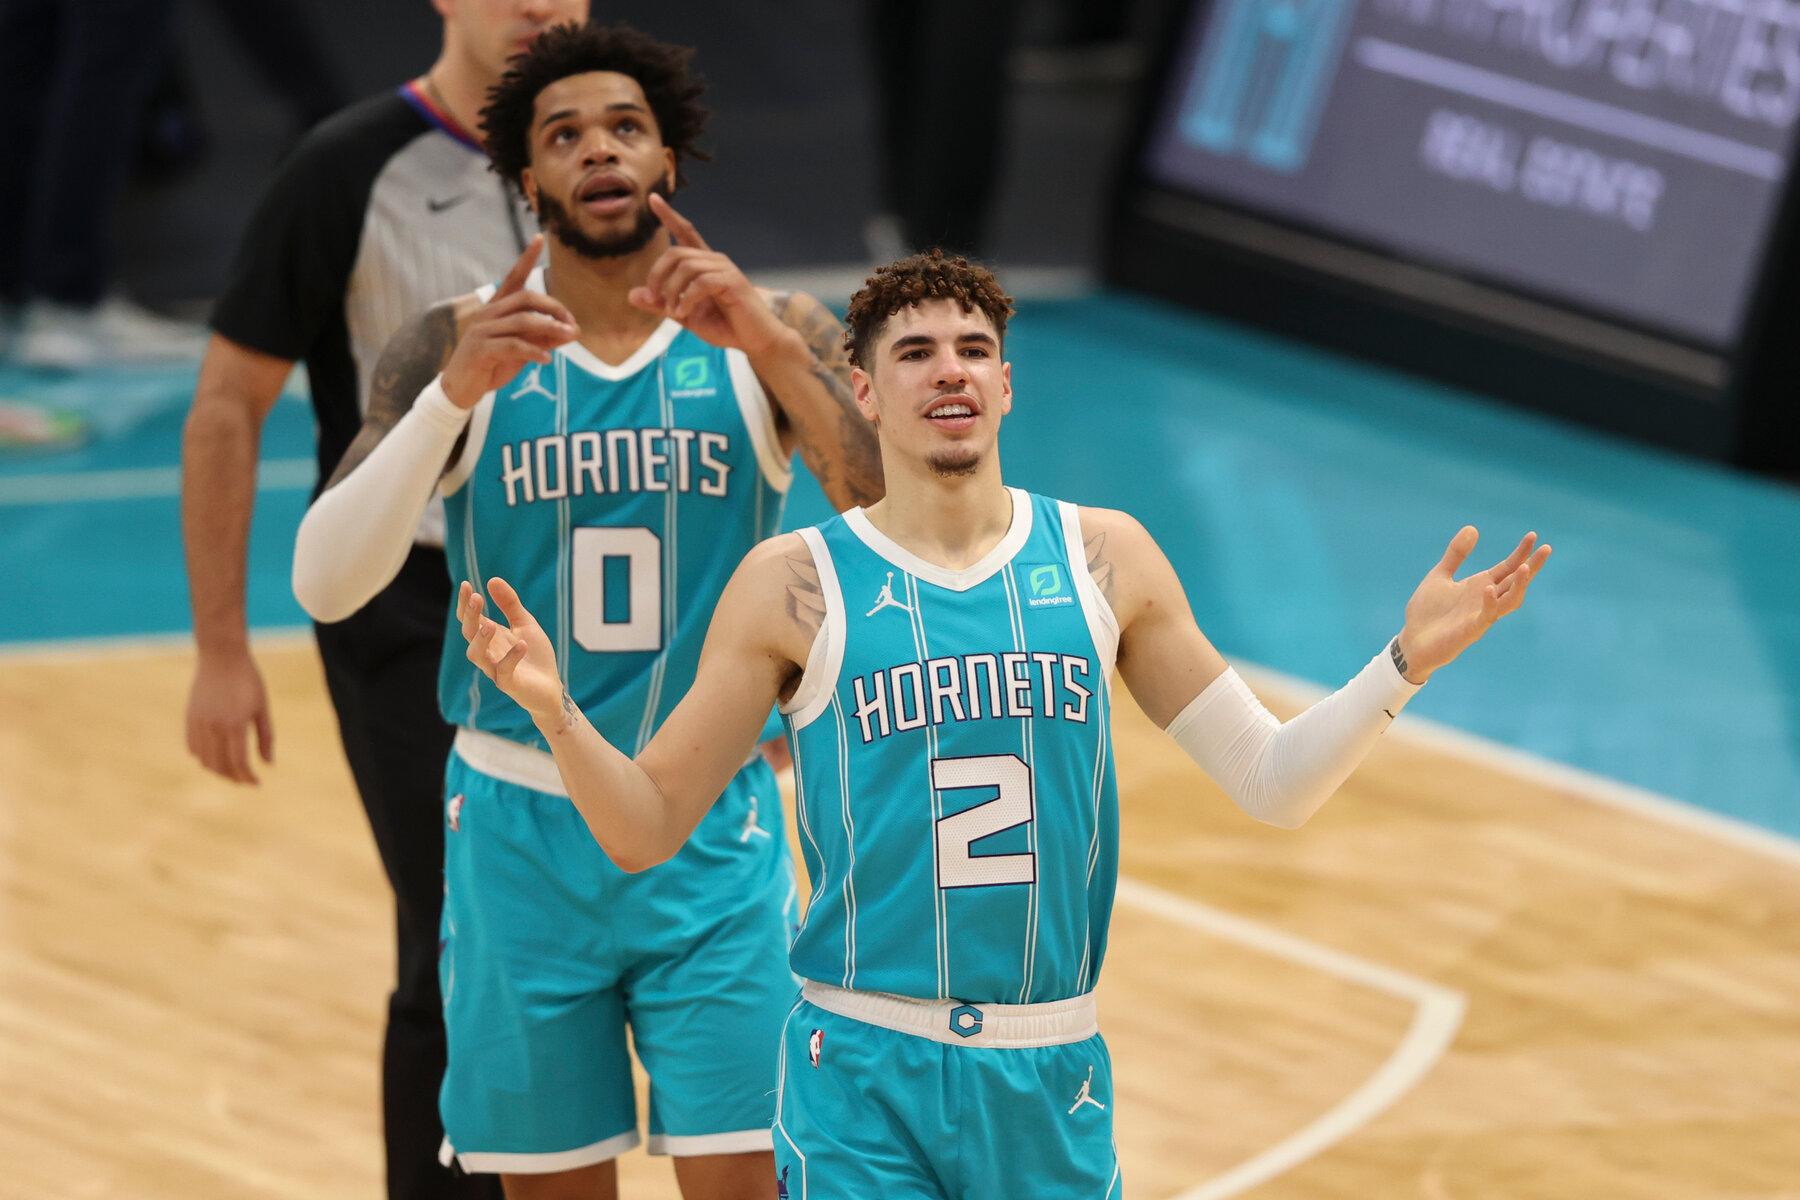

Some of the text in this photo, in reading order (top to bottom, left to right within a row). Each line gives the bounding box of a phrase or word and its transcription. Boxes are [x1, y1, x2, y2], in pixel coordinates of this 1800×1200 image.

[500, 428, 735, 507] HORNETS
[571, 525, 663, 653] 0
[1029, 596, 1072, 606] lendingtree
[851, 652, 1094, 745] HORNETS
[931, 753, 1037, 889] 2
